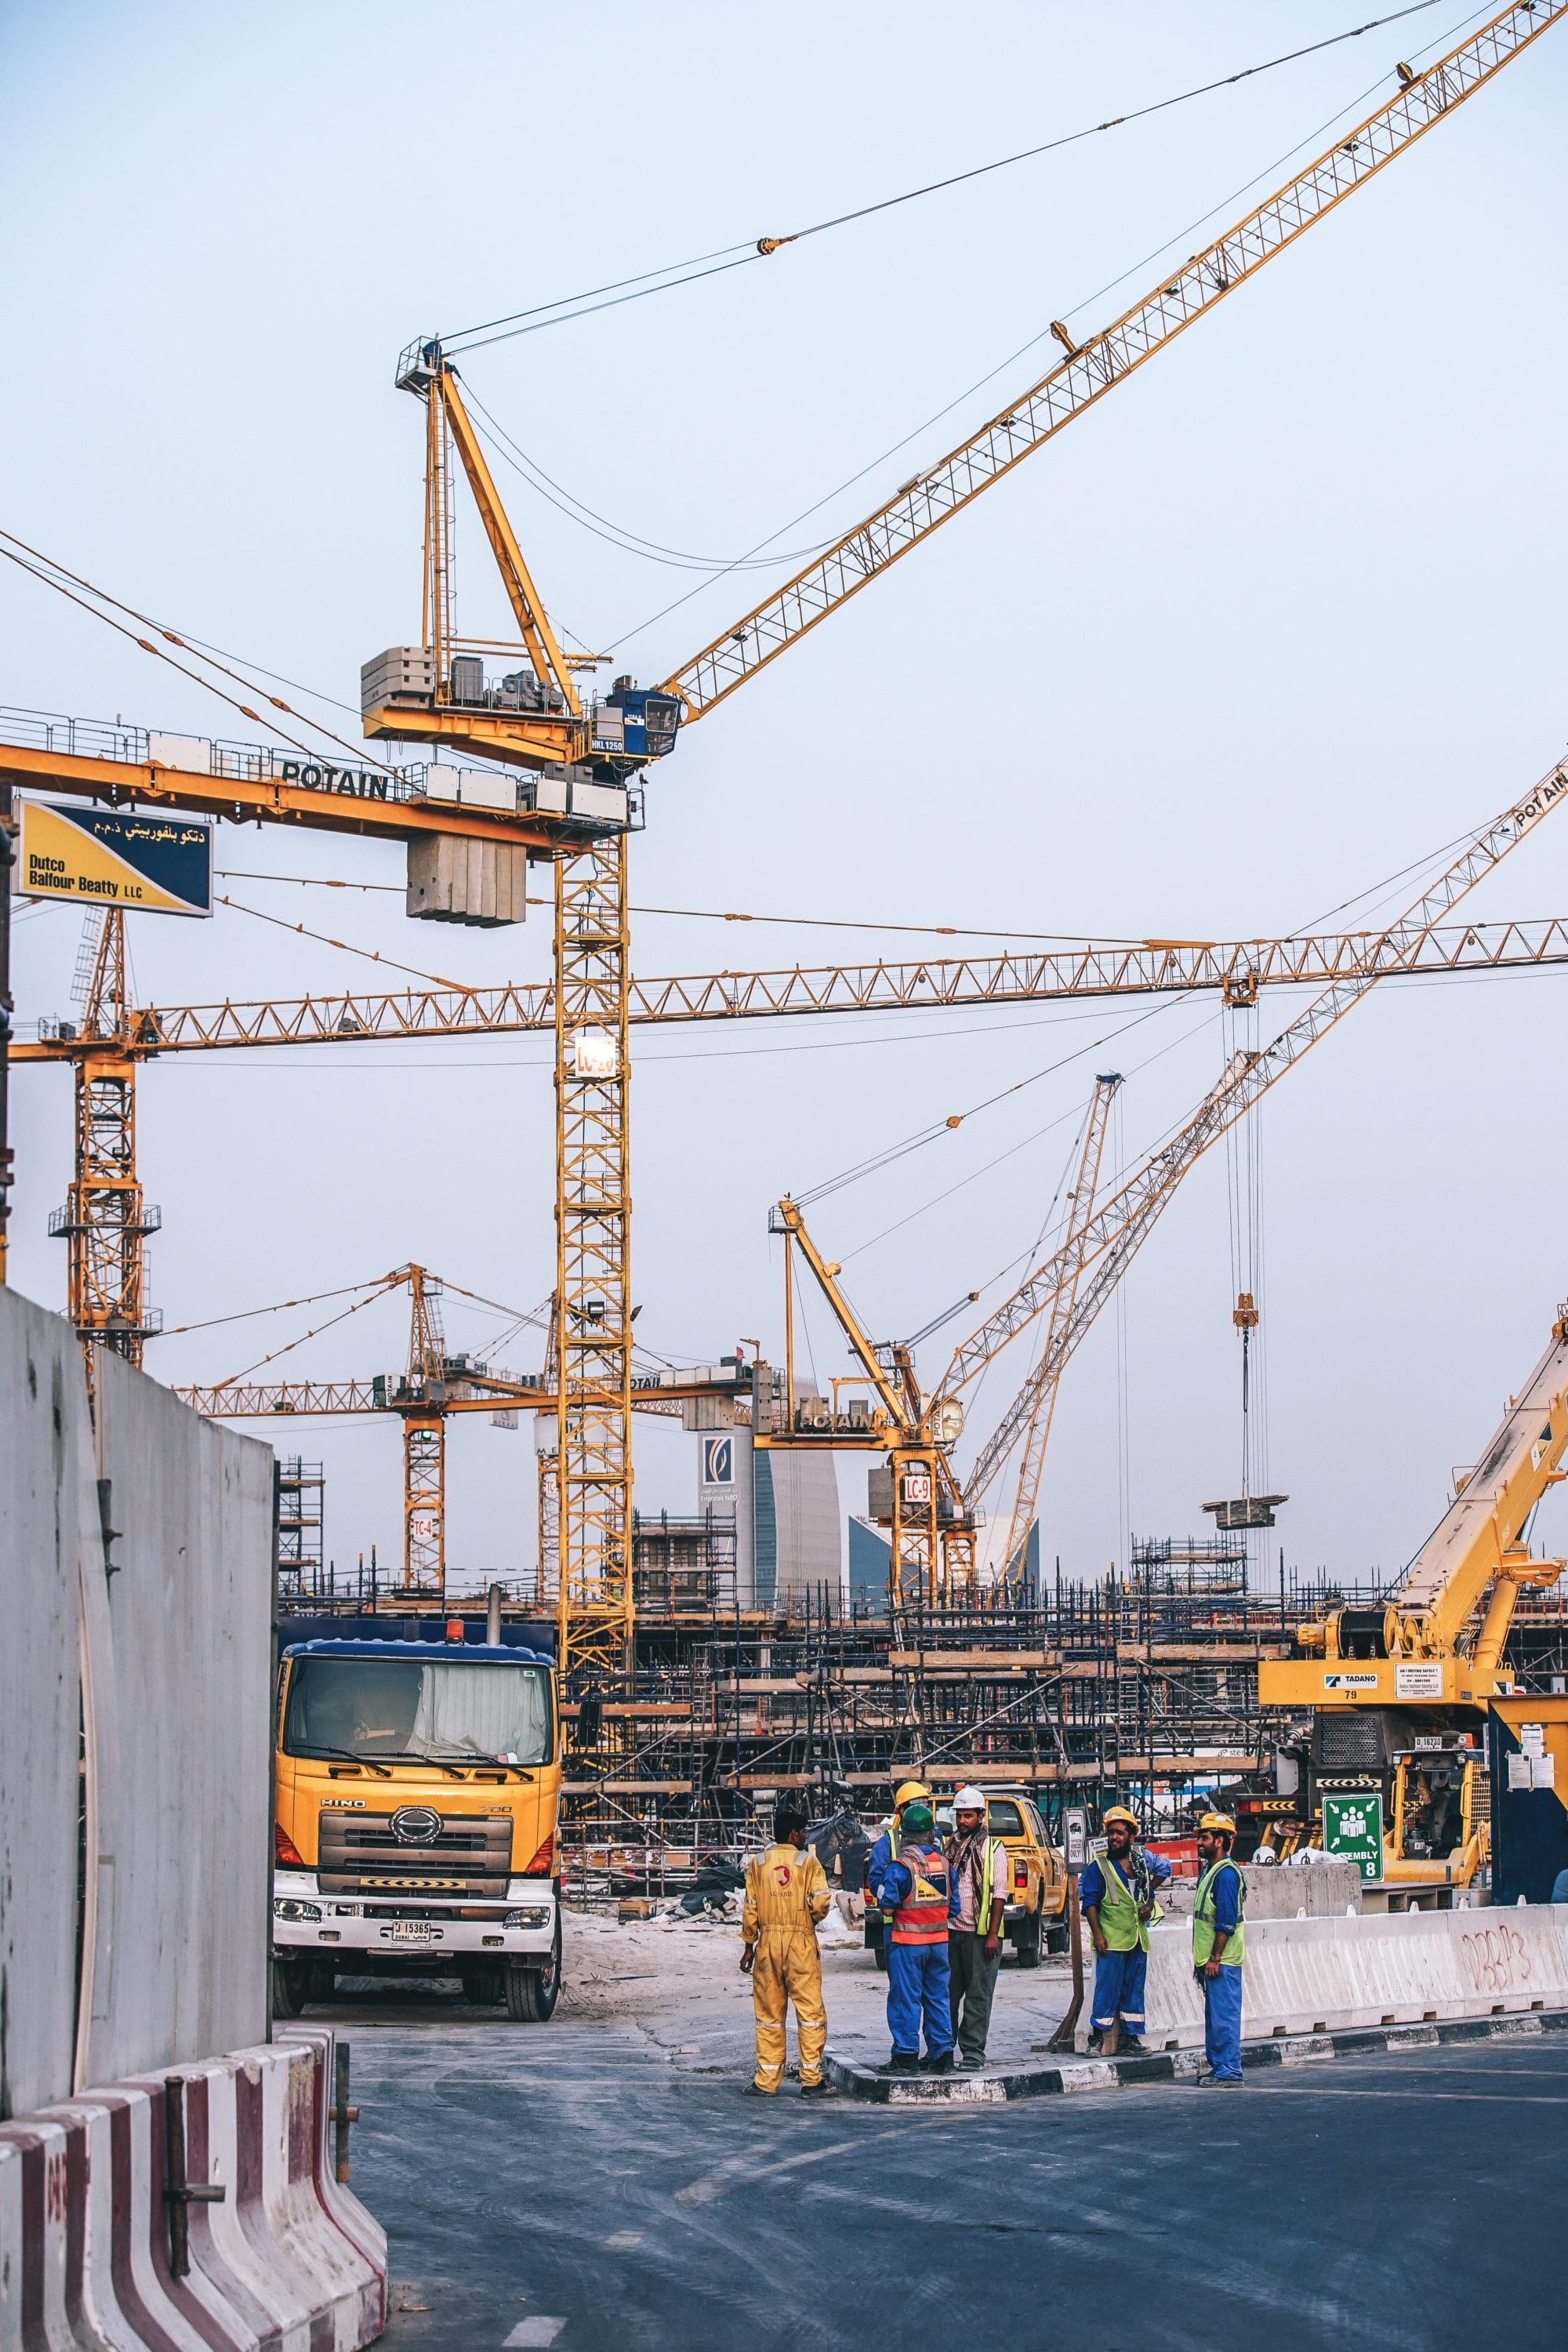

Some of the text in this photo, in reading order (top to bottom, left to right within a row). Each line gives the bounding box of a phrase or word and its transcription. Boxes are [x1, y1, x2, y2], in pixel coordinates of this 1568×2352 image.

[282, 761, 389, 800] POTAIN
[180, 829, 206, 845] دتكو
[29, 854, 65, 873] Dutco
[29, 870, 143, 899] Balfour Beatty LLC
[907, 1479, 928, 1499] LC-9
[414, 1520, 432, 1535] TC-4
[1345, 1690, 1357, 1700] 79
[321, 1798, 366, 1809] HINO
[1343, 1851, 1378, 1860] EMBLY
[1366, 1862, 1376, 1877] 8
[405, 1923, 429, 1934] 15365
